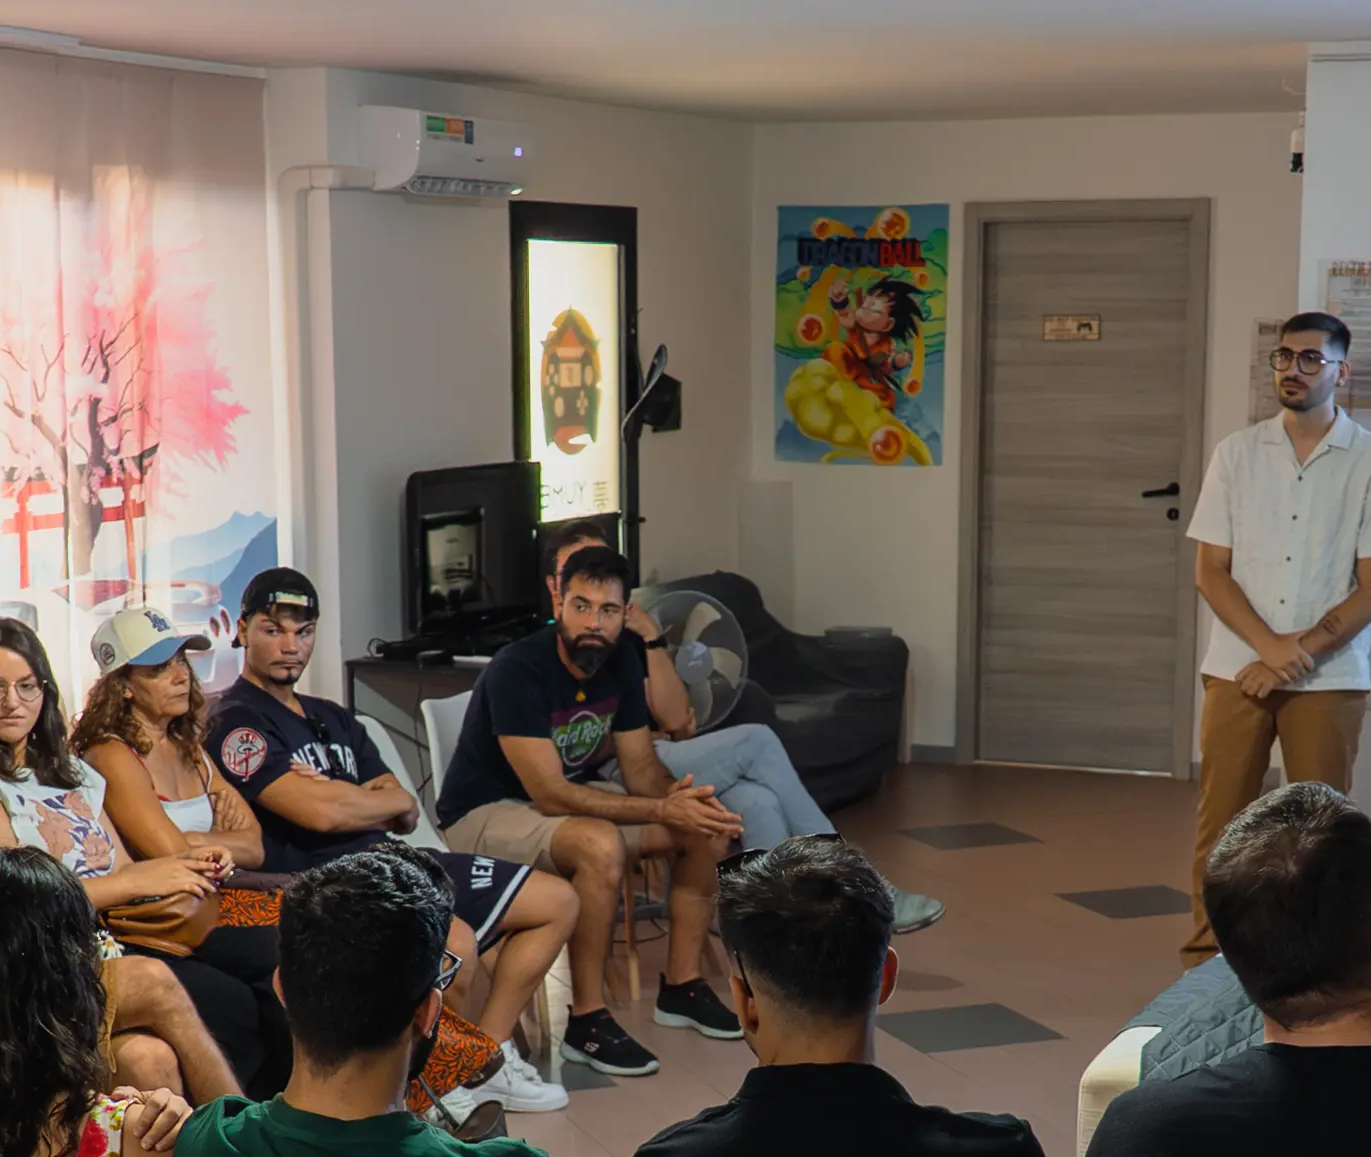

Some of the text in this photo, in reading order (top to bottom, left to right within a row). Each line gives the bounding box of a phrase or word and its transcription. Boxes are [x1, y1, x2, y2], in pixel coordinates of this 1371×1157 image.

[879, 239, 927, 268] BALL
[291, 741, 331, 772] NEW
[470, 855, 496, 889] NEW
